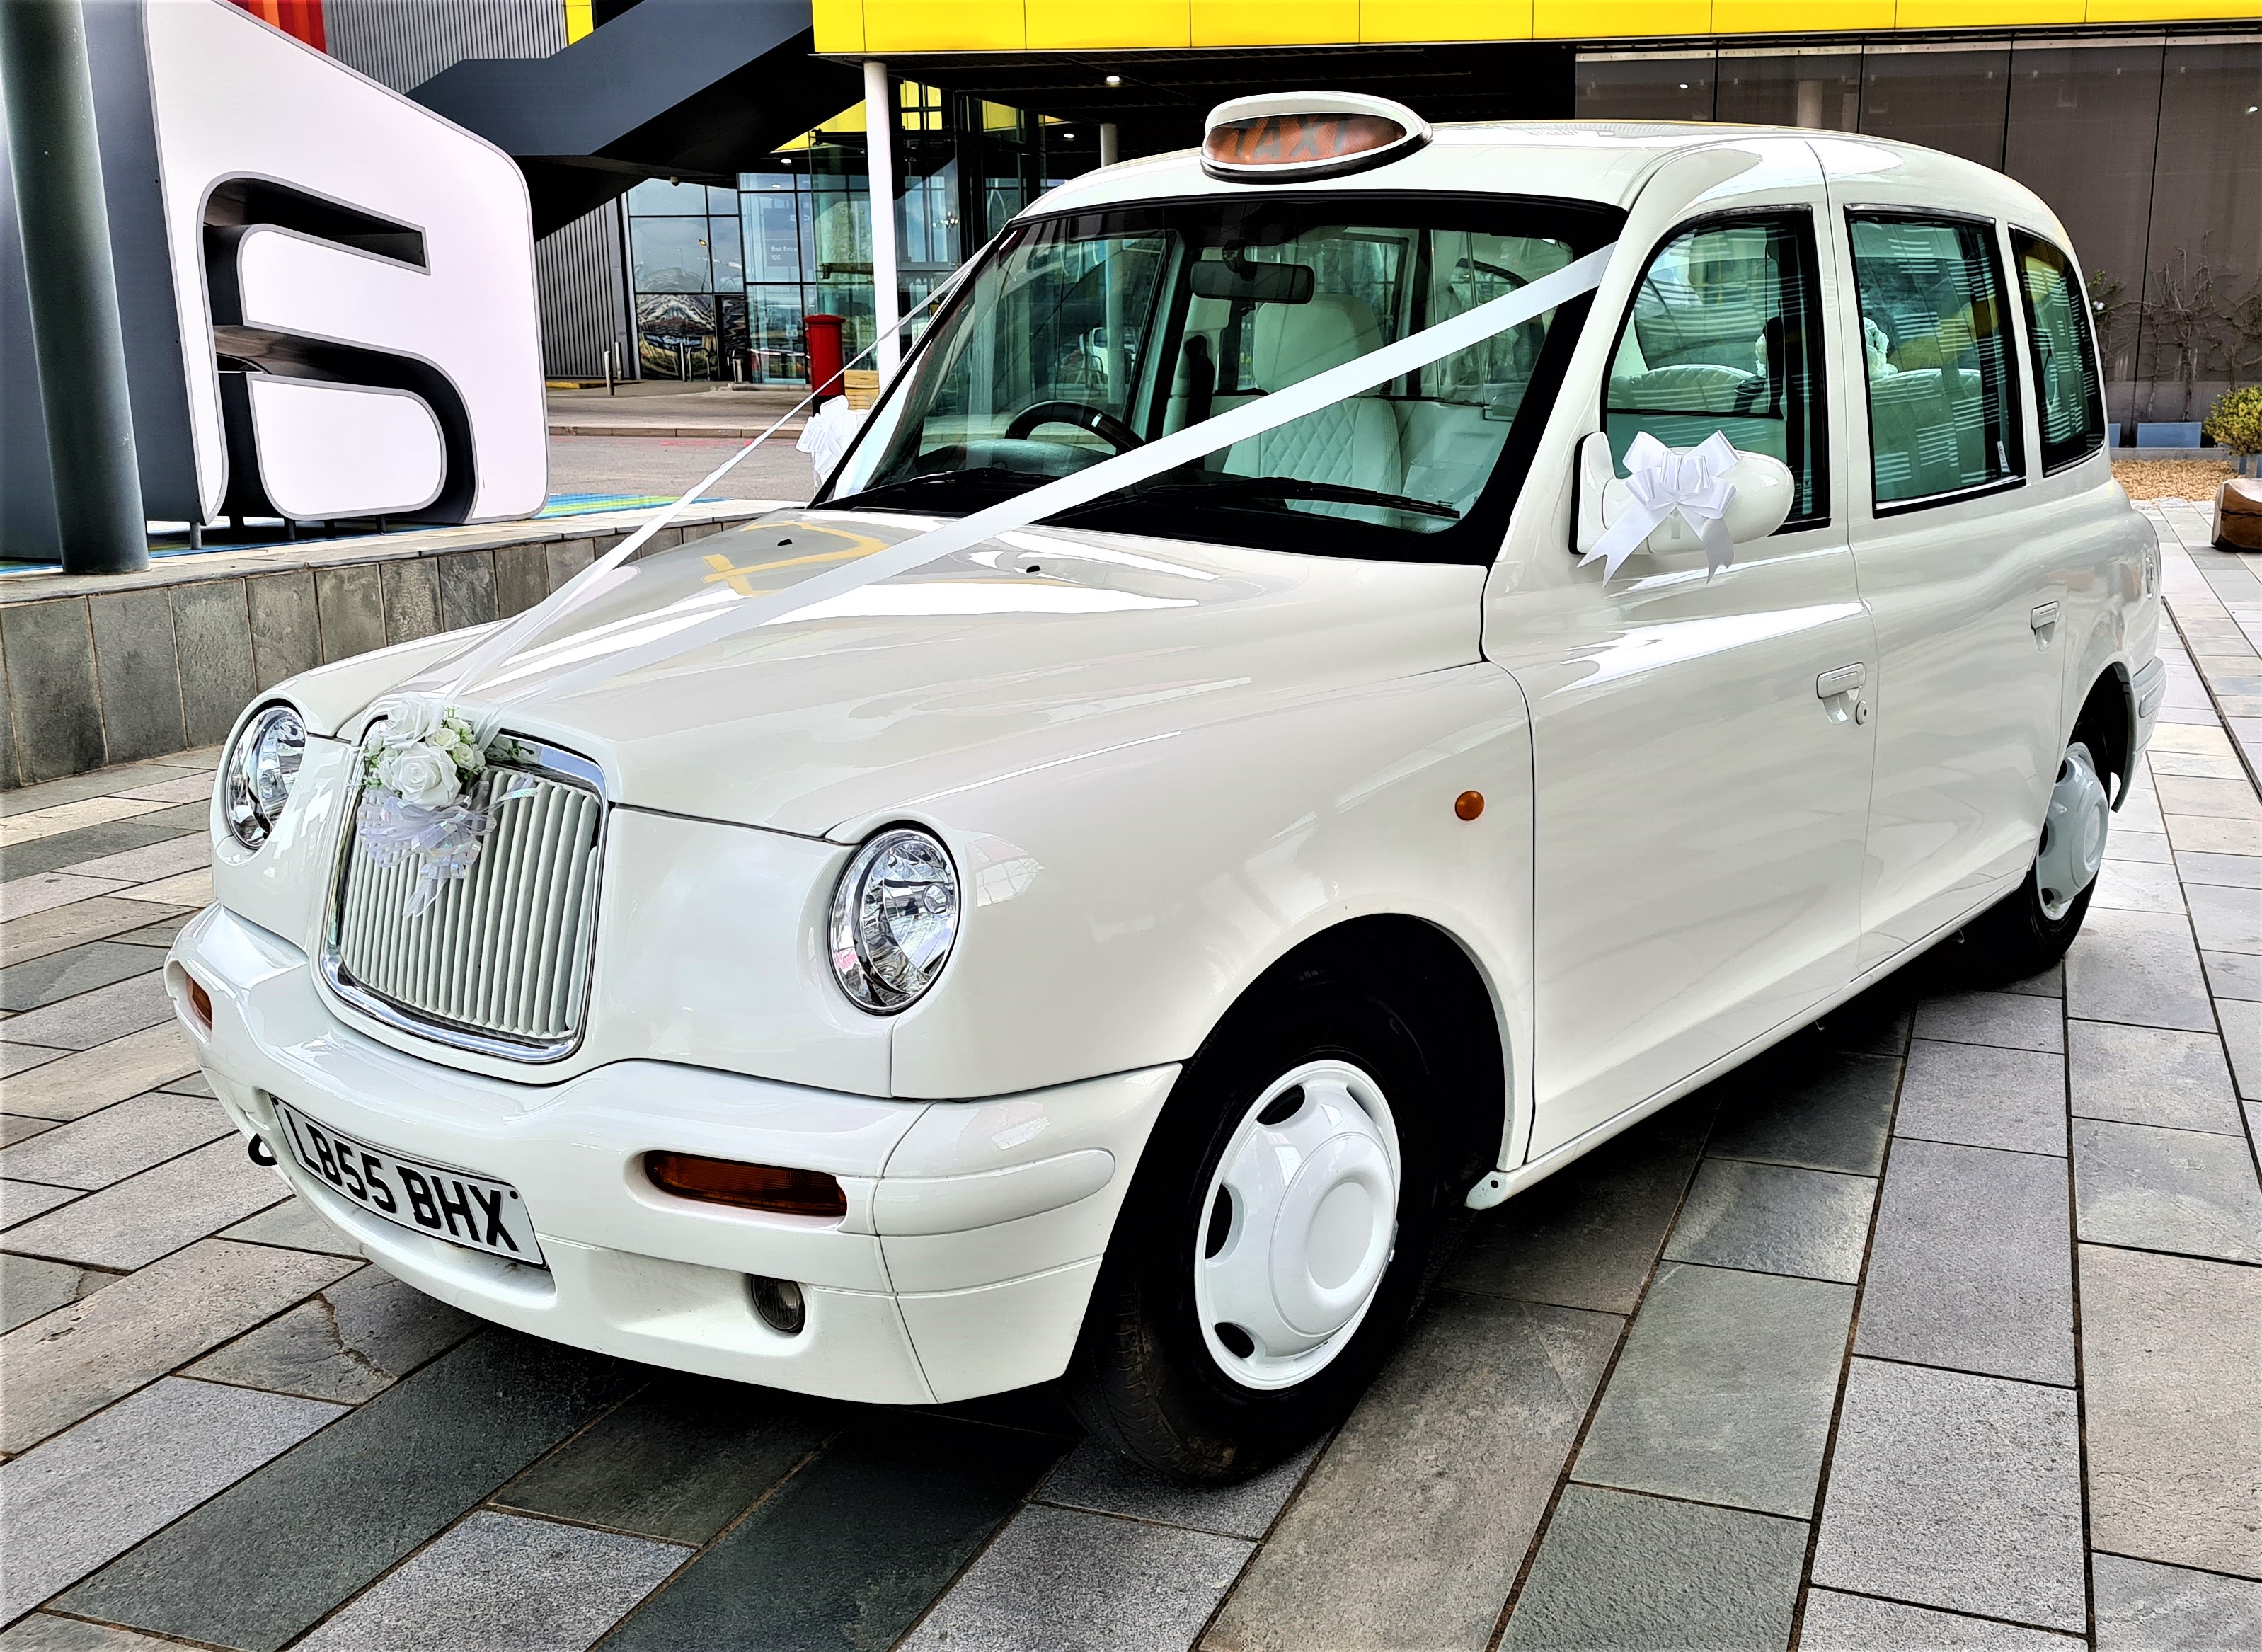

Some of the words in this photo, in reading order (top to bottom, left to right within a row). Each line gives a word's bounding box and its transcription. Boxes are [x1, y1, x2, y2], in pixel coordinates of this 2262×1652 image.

[1230, 115, 1350, 159] TAXI
[283, 1108, 398, 1214] LB55
[395, 1164, 519, 1253] BHX
